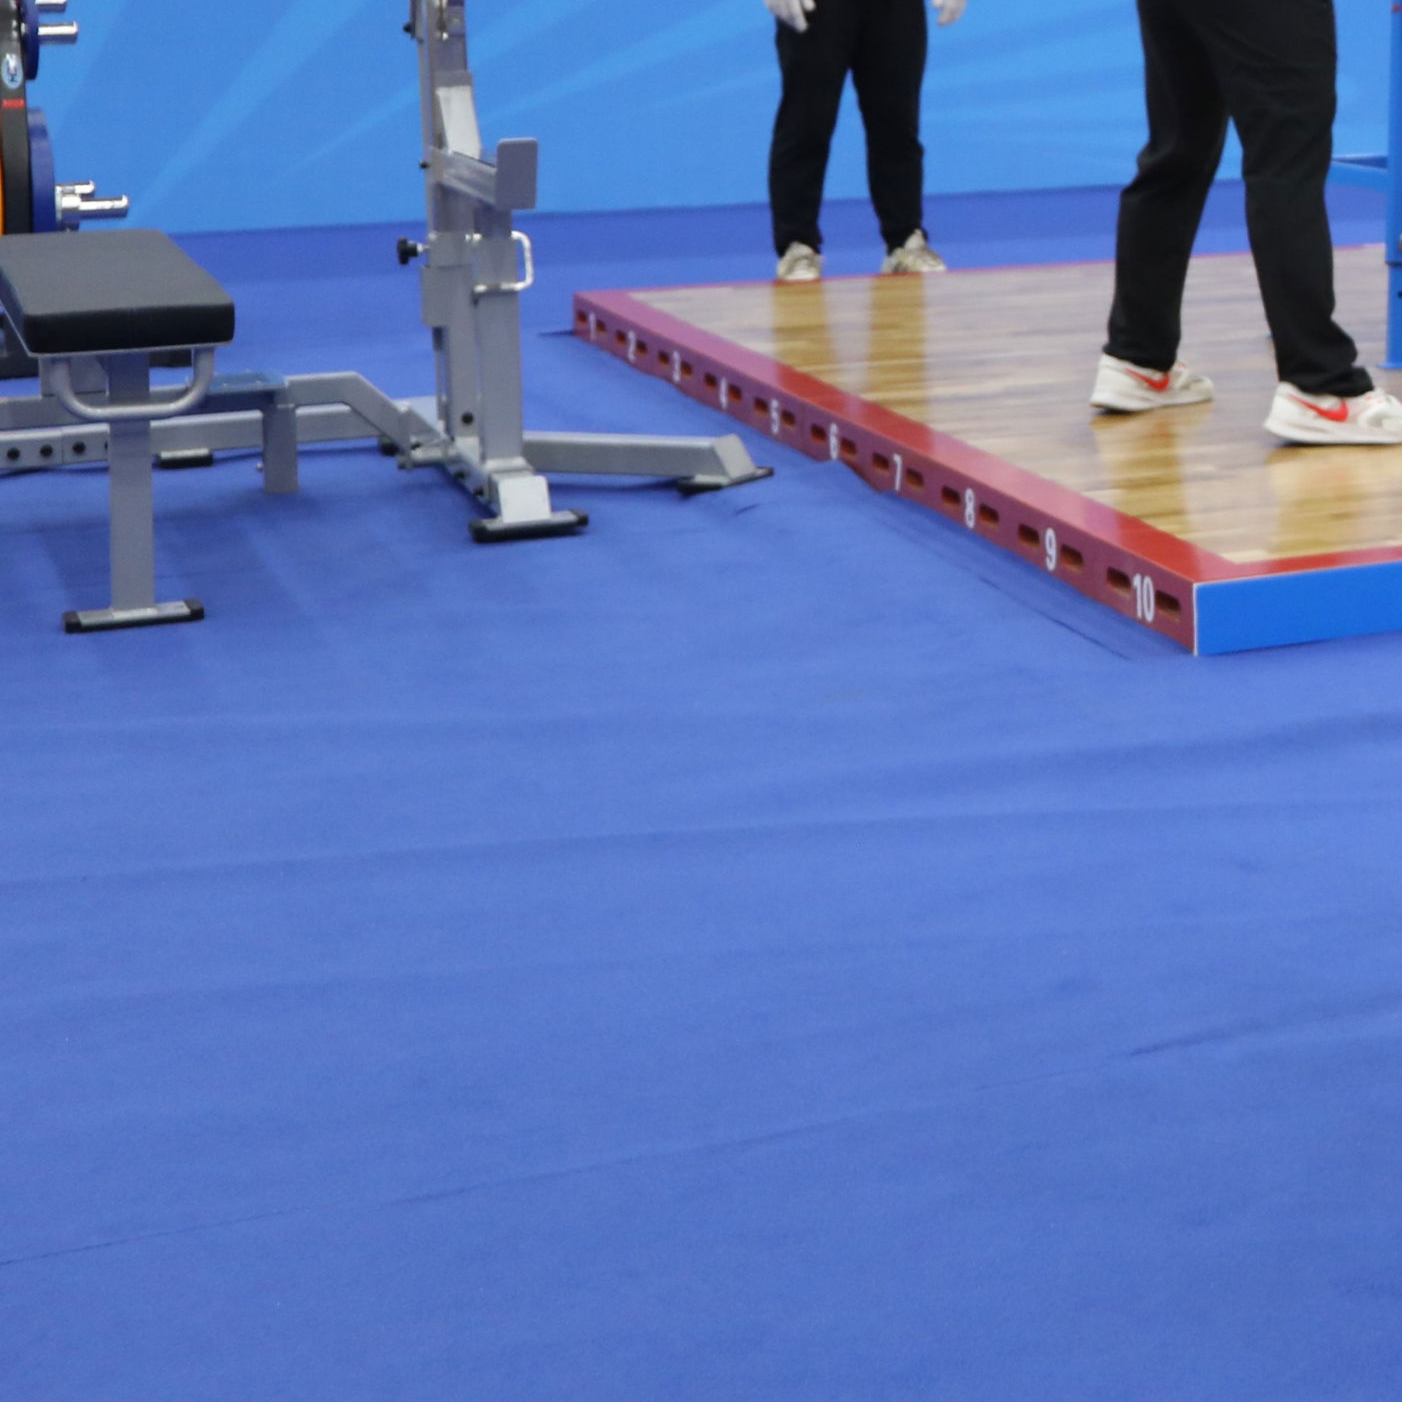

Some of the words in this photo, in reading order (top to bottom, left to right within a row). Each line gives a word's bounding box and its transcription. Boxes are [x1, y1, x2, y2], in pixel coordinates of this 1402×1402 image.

[627, 329, 637, 364] 2
[672, 350, 682, 384] 3
[770, 398, 781, 436] 5
[829, 422, 840, 461] 6
[893, 452, 903, 492] 7
[964, 487, 976, 529] 8
[1045, 527, 1058, 572] 9
[1133, 572, 1156, 623] 10
